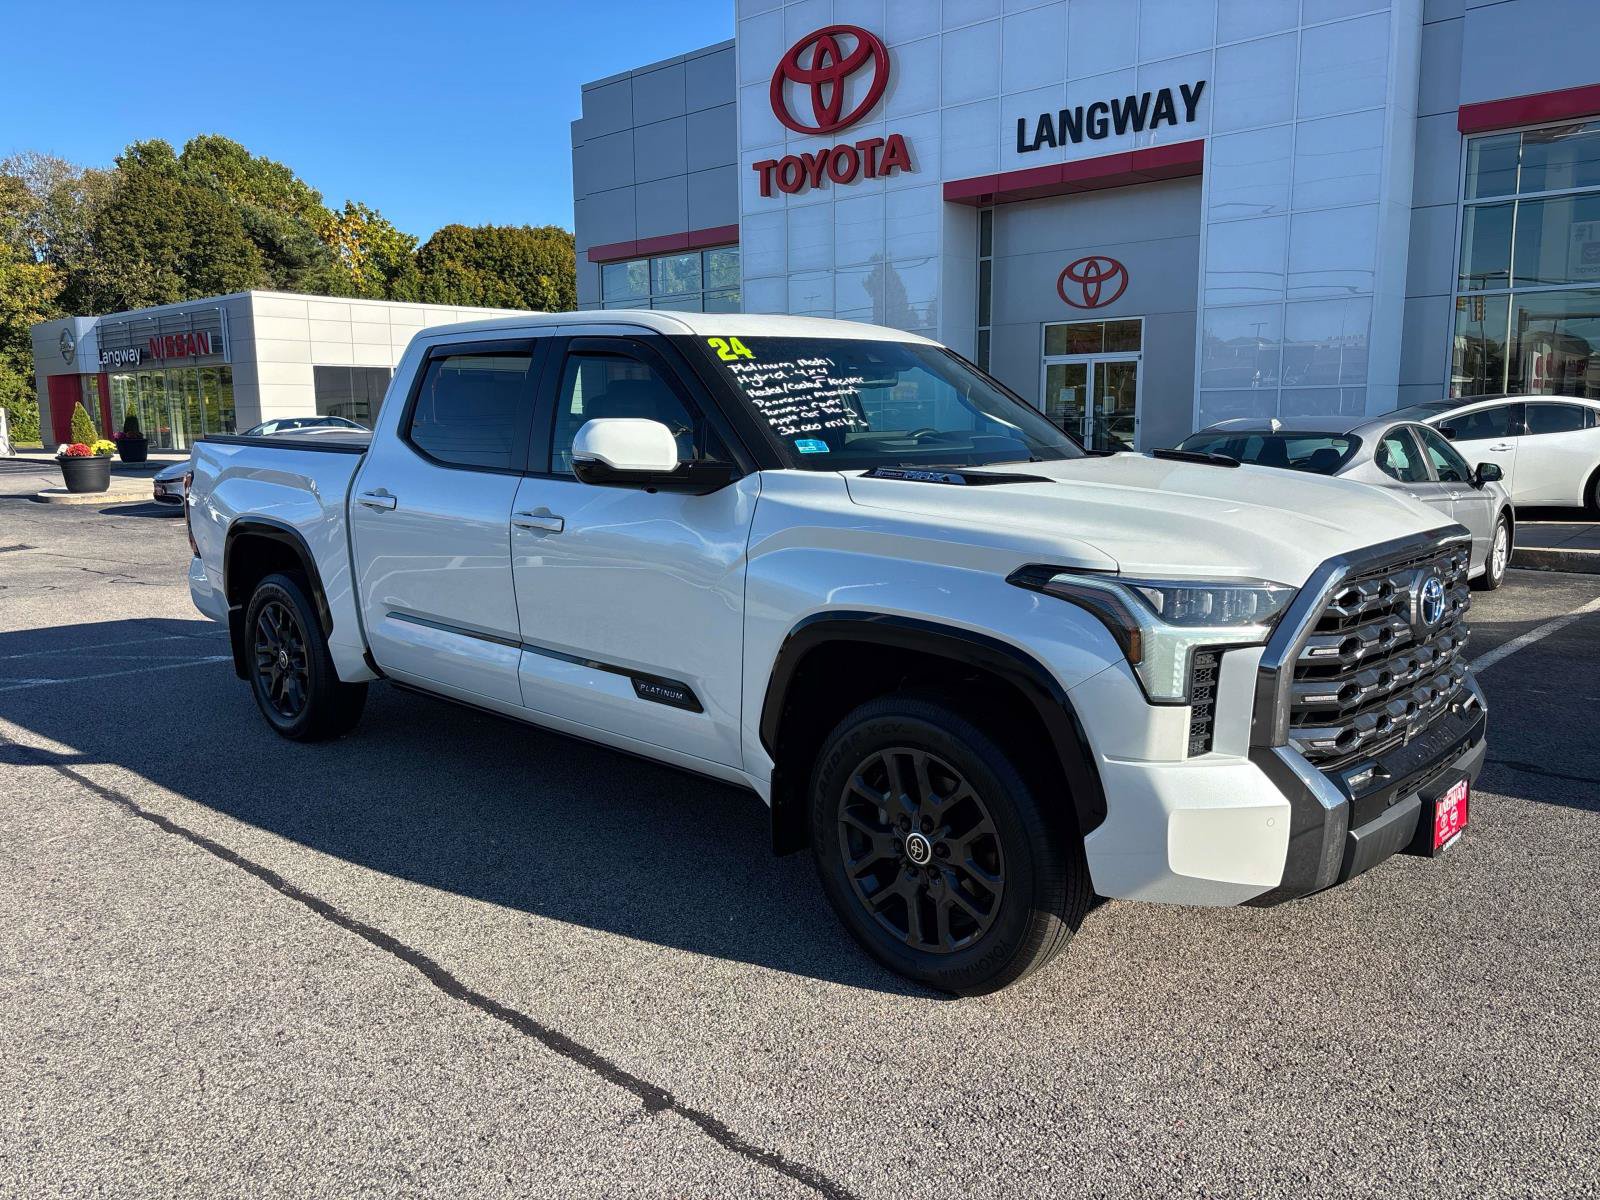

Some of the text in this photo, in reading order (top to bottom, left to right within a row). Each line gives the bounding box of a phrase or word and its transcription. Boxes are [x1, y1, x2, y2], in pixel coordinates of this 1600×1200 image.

[1017, 81, 1206, 153] LANGWAY
[753, 134, 912, 198] TOYOTA
[98, 331, 213, 367] Langway NISSAN
[708, 337, 755, 361] 24
[727, 363, 794, 374] Platinum
[640, 684, 683, 700] PLATINUM
